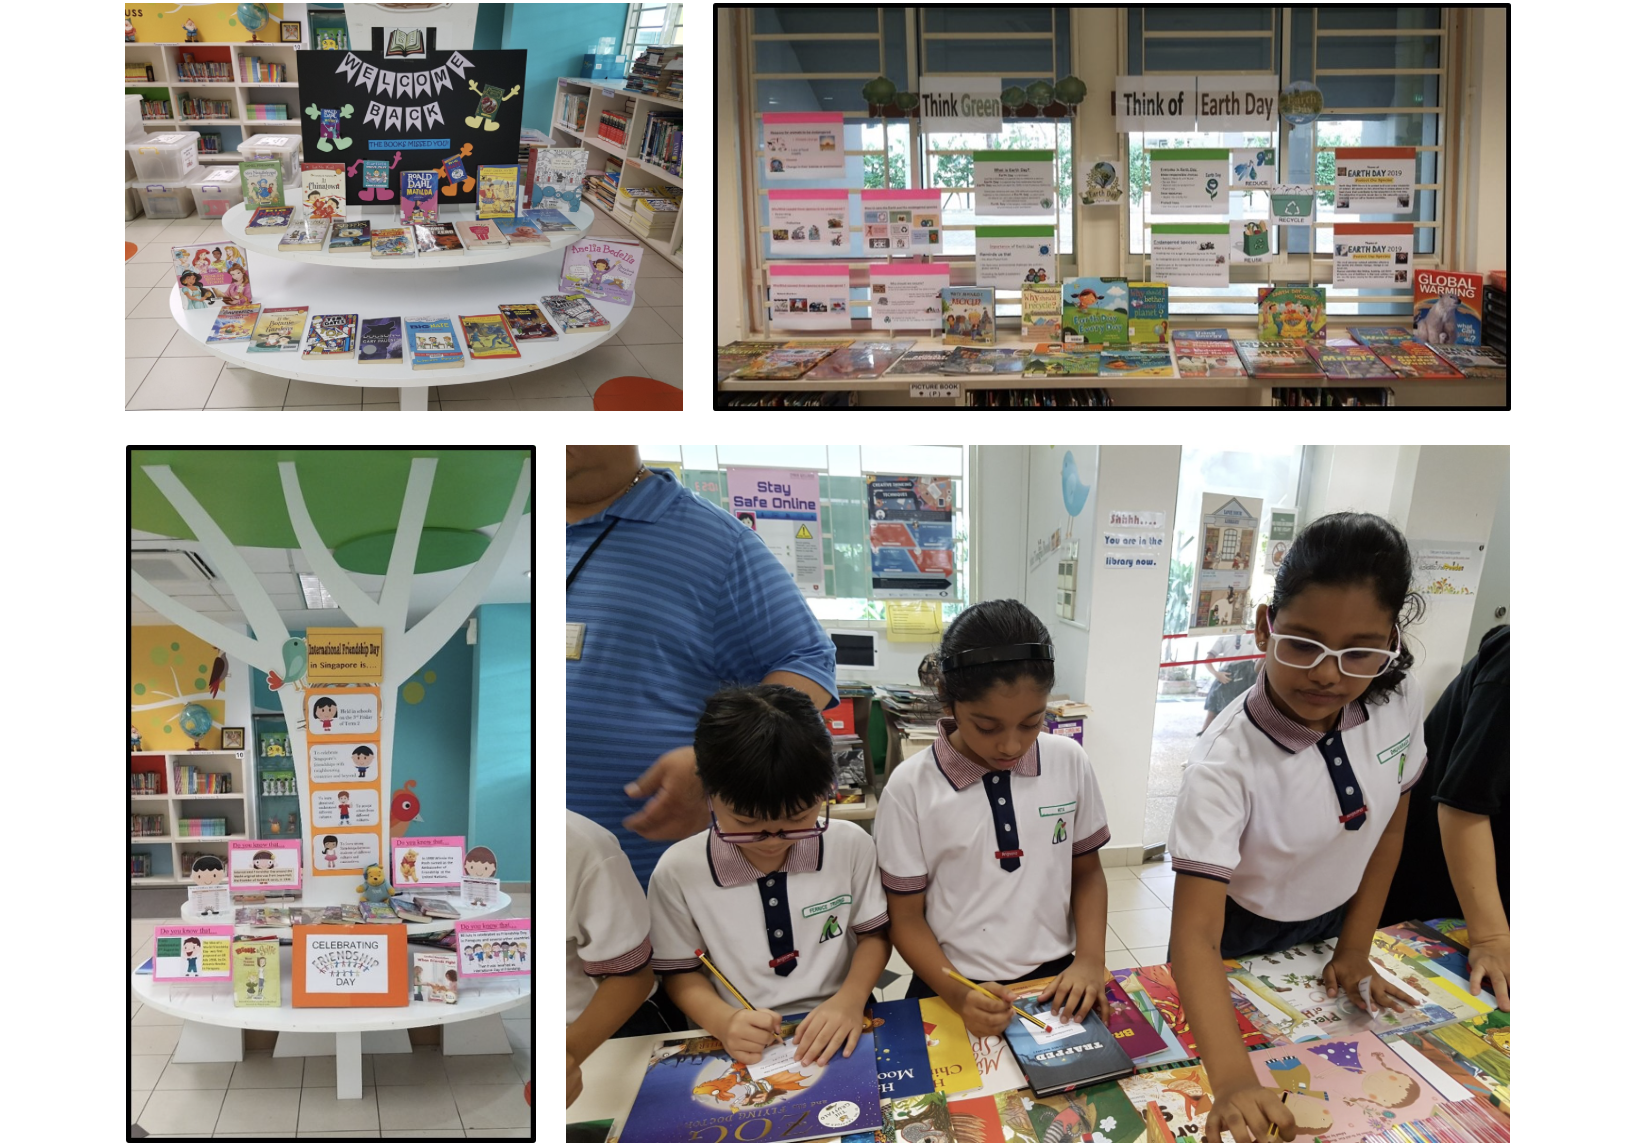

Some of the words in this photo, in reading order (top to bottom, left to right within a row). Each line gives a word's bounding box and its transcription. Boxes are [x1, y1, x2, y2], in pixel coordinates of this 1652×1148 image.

[345, 54, 464, 88] WELCOME
[922, 93, 958, 117] Think
[961, 95, 1000, 117] Green
[1123, 93, 1163, 117] Think
[1168, 91, 1184, 117] of
[1201, 92, 1240, 117] Earth
[1245, 92, 1273, 120] Day
[1287, 95, 1317, 105] Earth
[370, 104, 439, 121] BACK
[408, 180, 431, 188] DAHL
[572, 244, 601, 254] Amelia
[603, 244, 635, 265] Bedelia
[1418, 273, 1477, 290] GLOBAL
[1130, 289, 1144, 297] Why
[1420, 284, 1475, 298] WARMING
[1024, 294, 1039, 304] Why
[1029, 302, 1057, 310] recycle?
[1073, 315, 1099, 324] Earth
[1101, 315, 1117, 325] Day
[1134, 309, 1157, 319] planet
[1079, 324, 1101, 333] Every
[1106, 323, 1123, 333] Day
[757, 481, 791, 496] Stay
[734, 496, 767, 508] Safe
[772, 497, 816, 510] Online
[1105, 535, 1120, 544] You
[1139, 537, 1146, 545] in
[1149, 537, 1162, 545] the
[1105, 557, 1133, 567] library
[308, 642, 341, 655] International
[342, 642, 369, 657] Friendship
[370, 644, 380, 657] Day
[320, 662, 357, 670] Singapore
[312, 941, 379, 949] CELEBRATING
[312, 950, 379, 970] FRIENDSHIP
[336, 978, 356, 986] DAY
[1035, 1042, 1103, 1061] TRAPPED
[739, 1106, 788, 1119] FLYING
[681, 1114, 733, 1129] DOCTOR
[688, 1109, 811, 1143] ZOG
